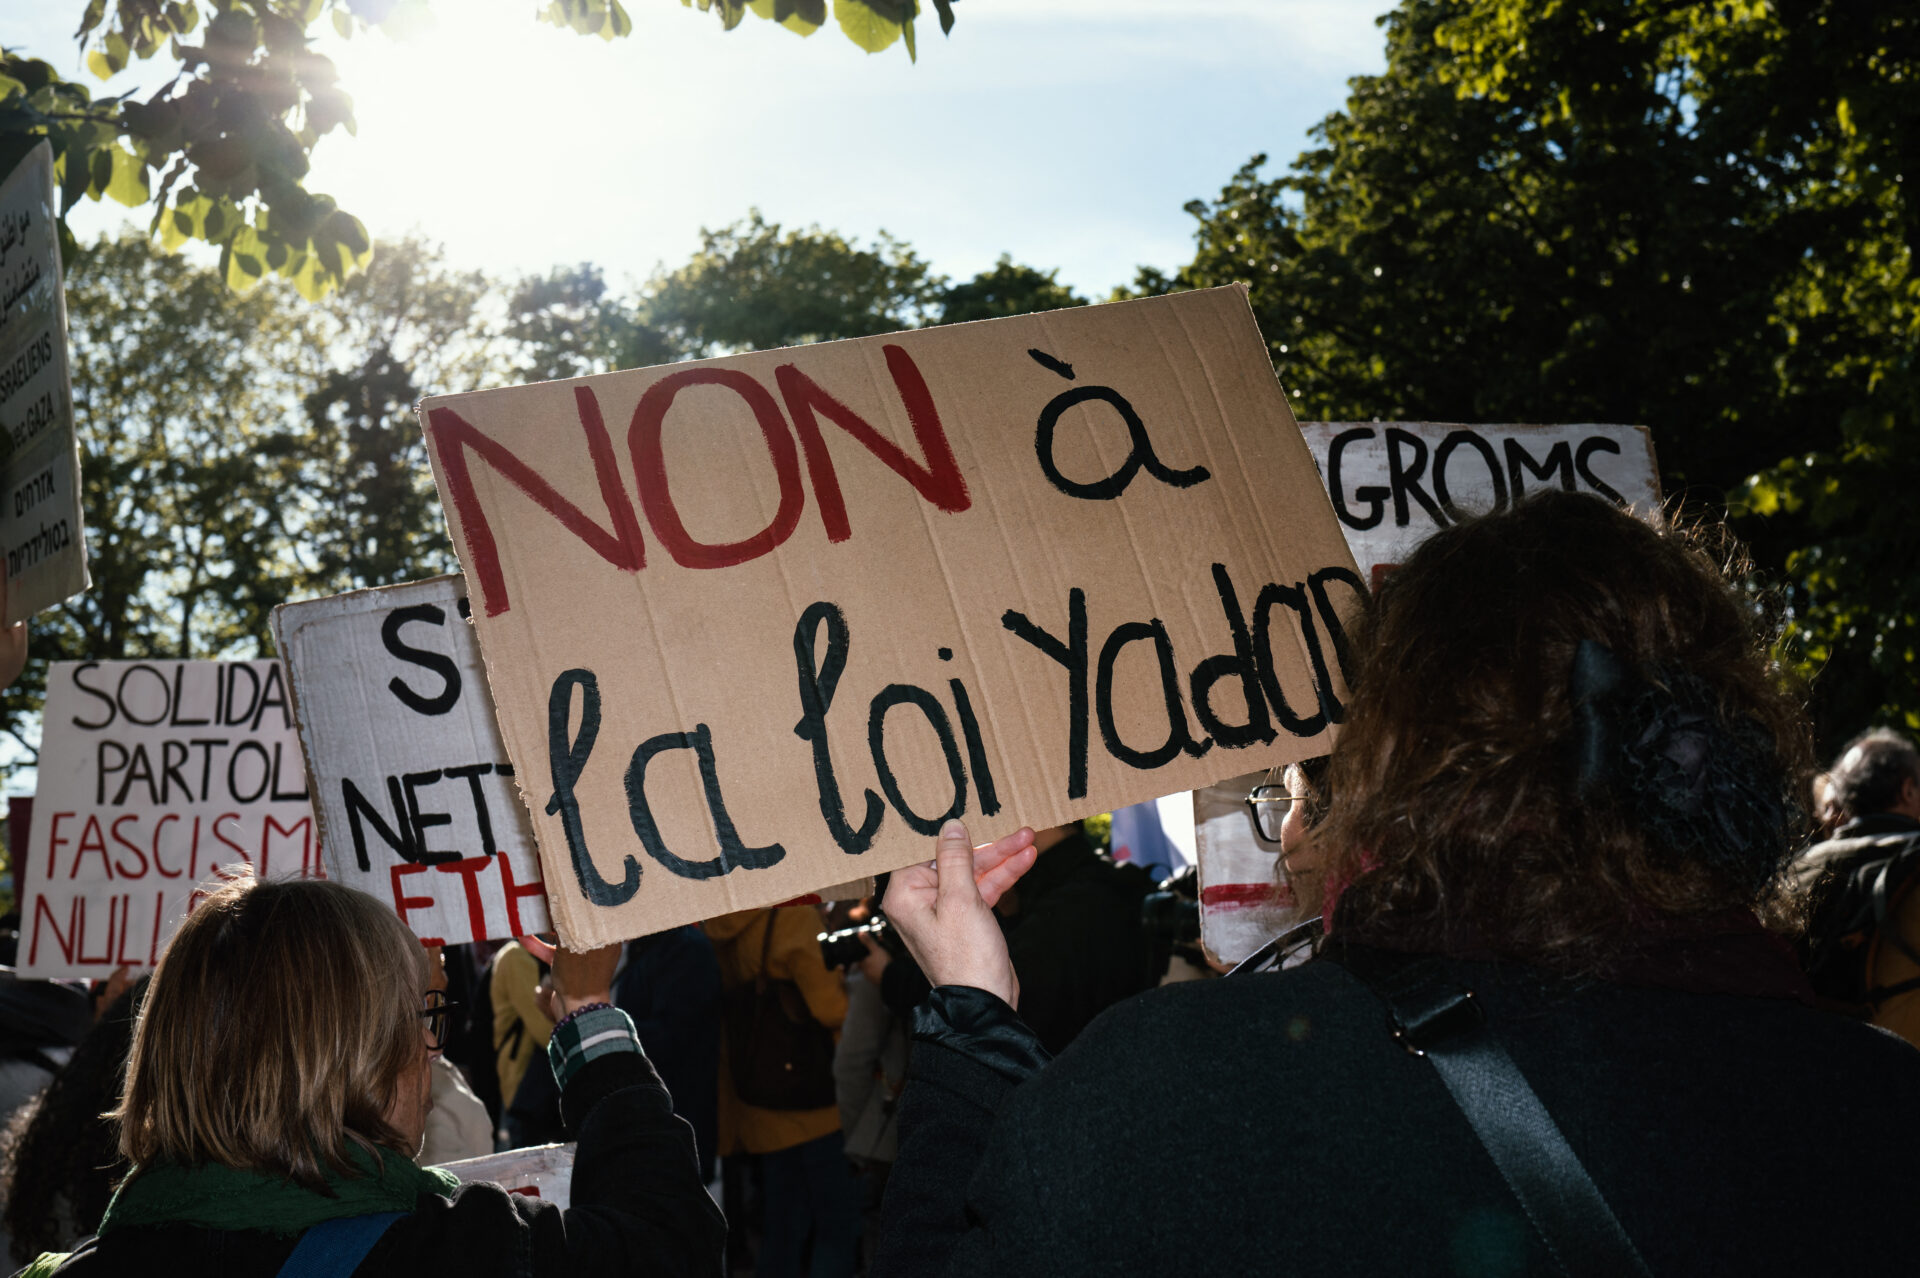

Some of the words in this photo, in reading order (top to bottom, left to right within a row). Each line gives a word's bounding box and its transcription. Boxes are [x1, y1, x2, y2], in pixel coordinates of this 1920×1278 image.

[27, 391, 55, 438] GAZA
[14, 466, 56, 518] אזרחים
[428, 344, 972, 618] NON
[1026, 347, 1211, 501] à
[1314, 427, 1628, 531] GROMS
[8, 518, 71, 577] בסולידריות
[71, 662, 299, 731] SOLIDA
[380, 598, 471, 716] S
[545, 668, 787, 907] la
[792, 601, 1002, 855] loi
[1001, 563, 1372, 800] Yadan
[341, 763, 536, 872] NET
[28, 889, 212, 968] NULL
